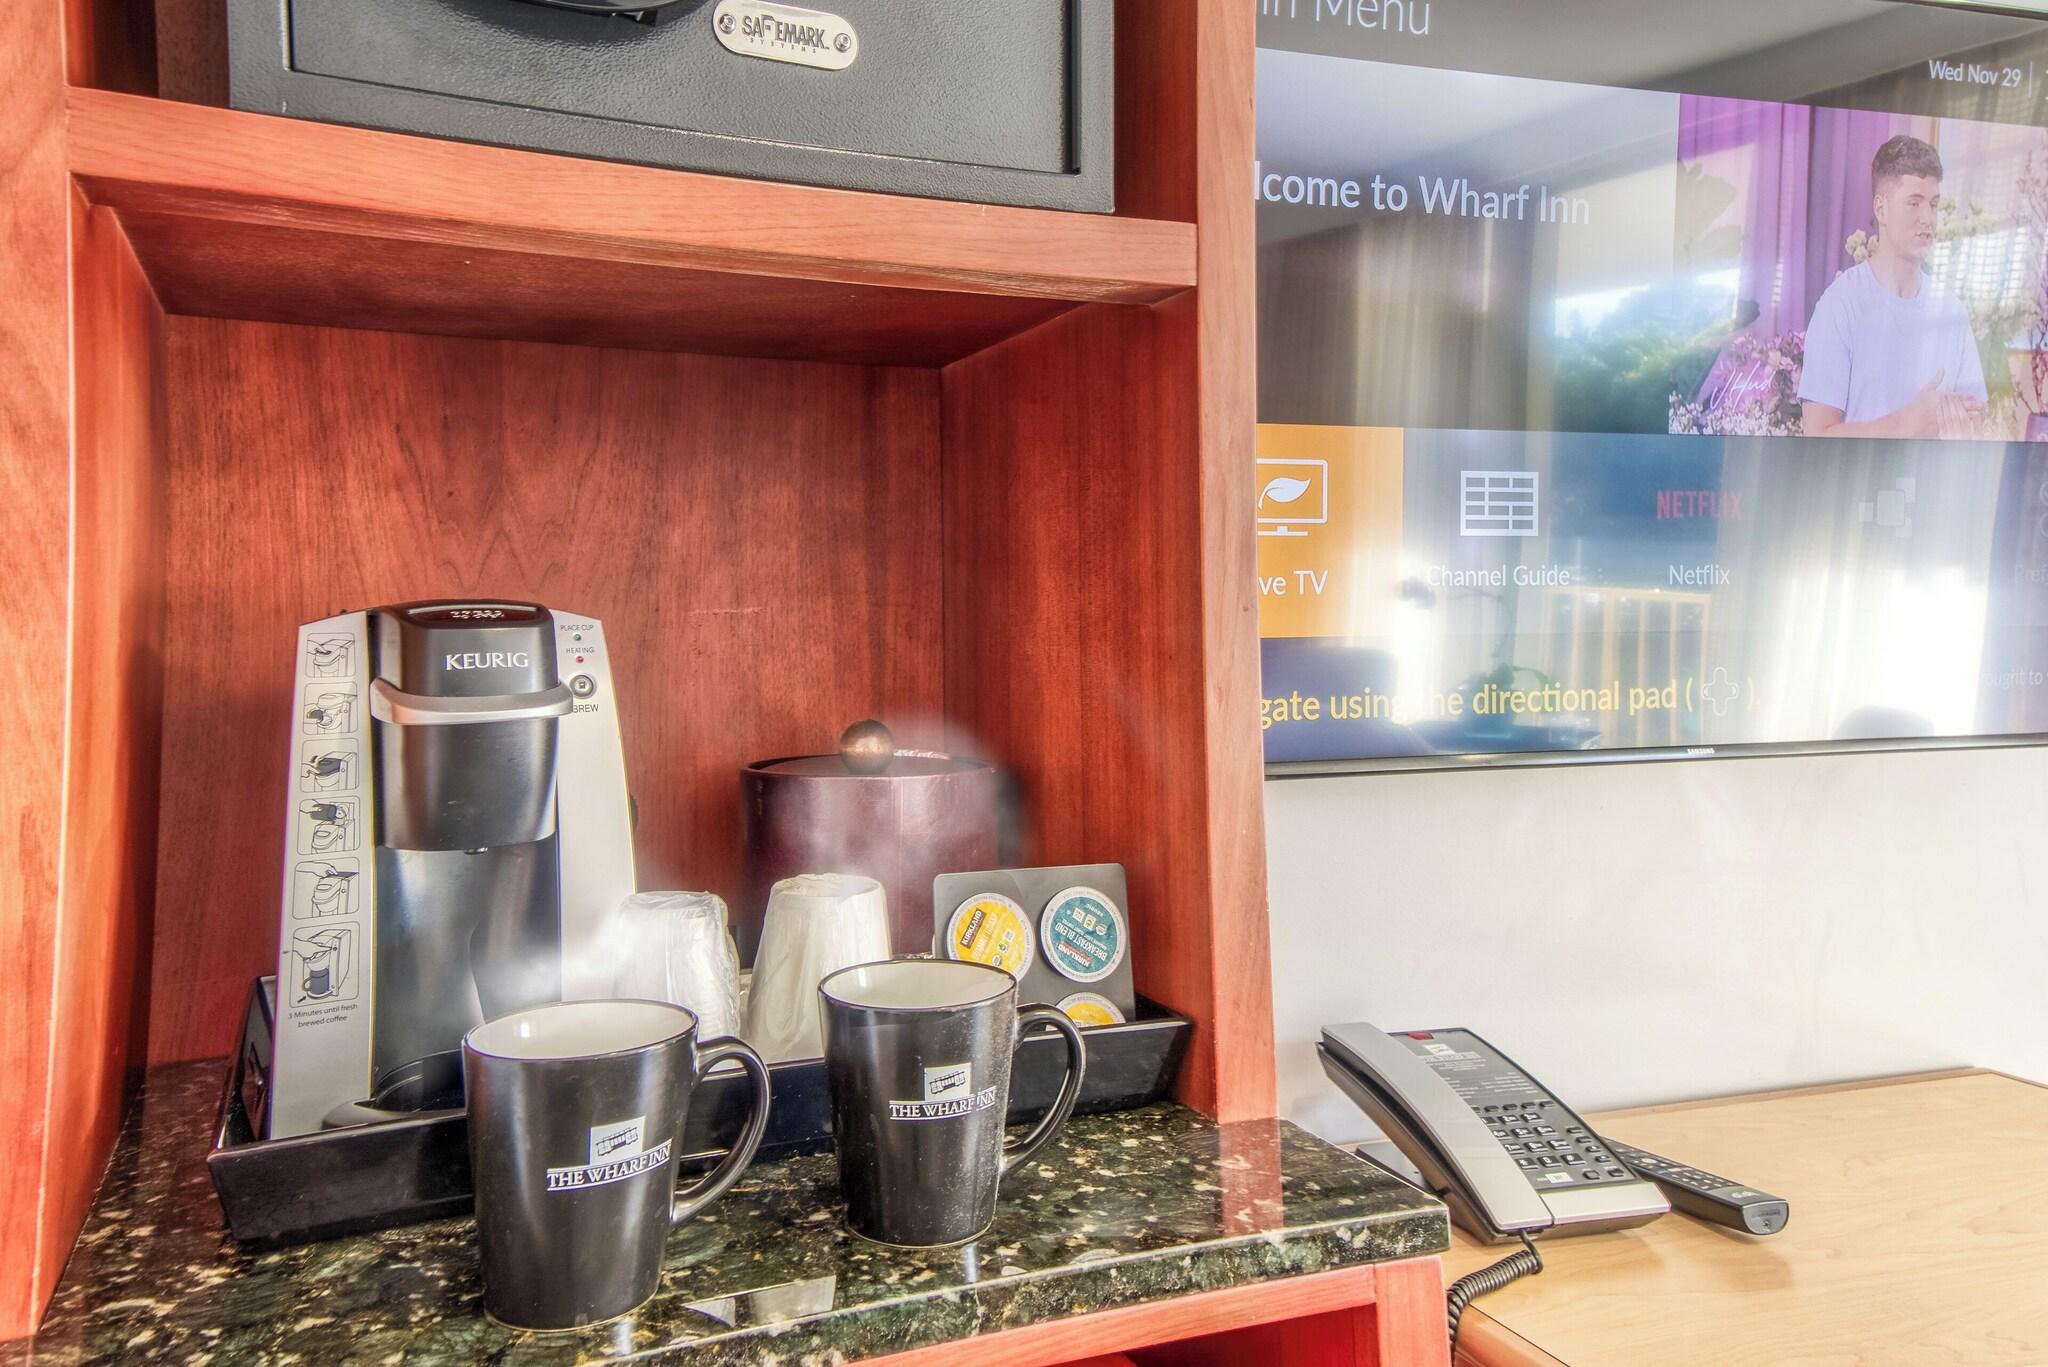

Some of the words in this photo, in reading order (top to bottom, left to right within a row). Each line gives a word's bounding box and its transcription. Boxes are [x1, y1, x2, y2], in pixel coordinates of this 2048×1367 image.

[742, 15, 826, 48] SAFEMARK
[1315, 0, 1430, 35] Menu
[1929, 59, 1964, 82] Wed
[1967, 63, 1998, 86] Nov
[2001, 67, 2022, 88] 29
[1371, 174, 1408, 212] to
[1418, 175, 1530, 221] Wharf
[1540, 184, 1590, 225] Inn
[1656, 489, 1744, 520] NETFLIX
[1293, 570, 1329, 595] TV
[1426, 563, 1507, 587] Channel
[1512, 564, 1571, 587] Guide
[1668, 563, 1731, 585] Netflix
[445, 652, 529, 671] KEURIG
[1409, 690, 1464, 717] he
[1472, 679, 1620, 715] directional
[1629, 678, 1678, 716] pad
[961, 910, 982, 946] KIRKLAND
[1055, 922, 1076, 940] BLEND
[1073, 935, 1108, 961] BREAKFAST
[294, 1008, 323, 1019] Minutes
[324, 1004, 340, 1015] until
[341, 1003, 358, 1012] fresh
[298, 1017, 325, 1028] brewed
[326, 1014, 348, 1024] coffee
[889, 1104, 921, 1118] THE
[922, 1098, 975, 1117] WHARF
[976, 1089, 996, 1107] INN
[547, 1171, 585, 1189] THE
[586, 1158, 648, 1183] WHARF
[648, 1143, 673, 1168] INN
